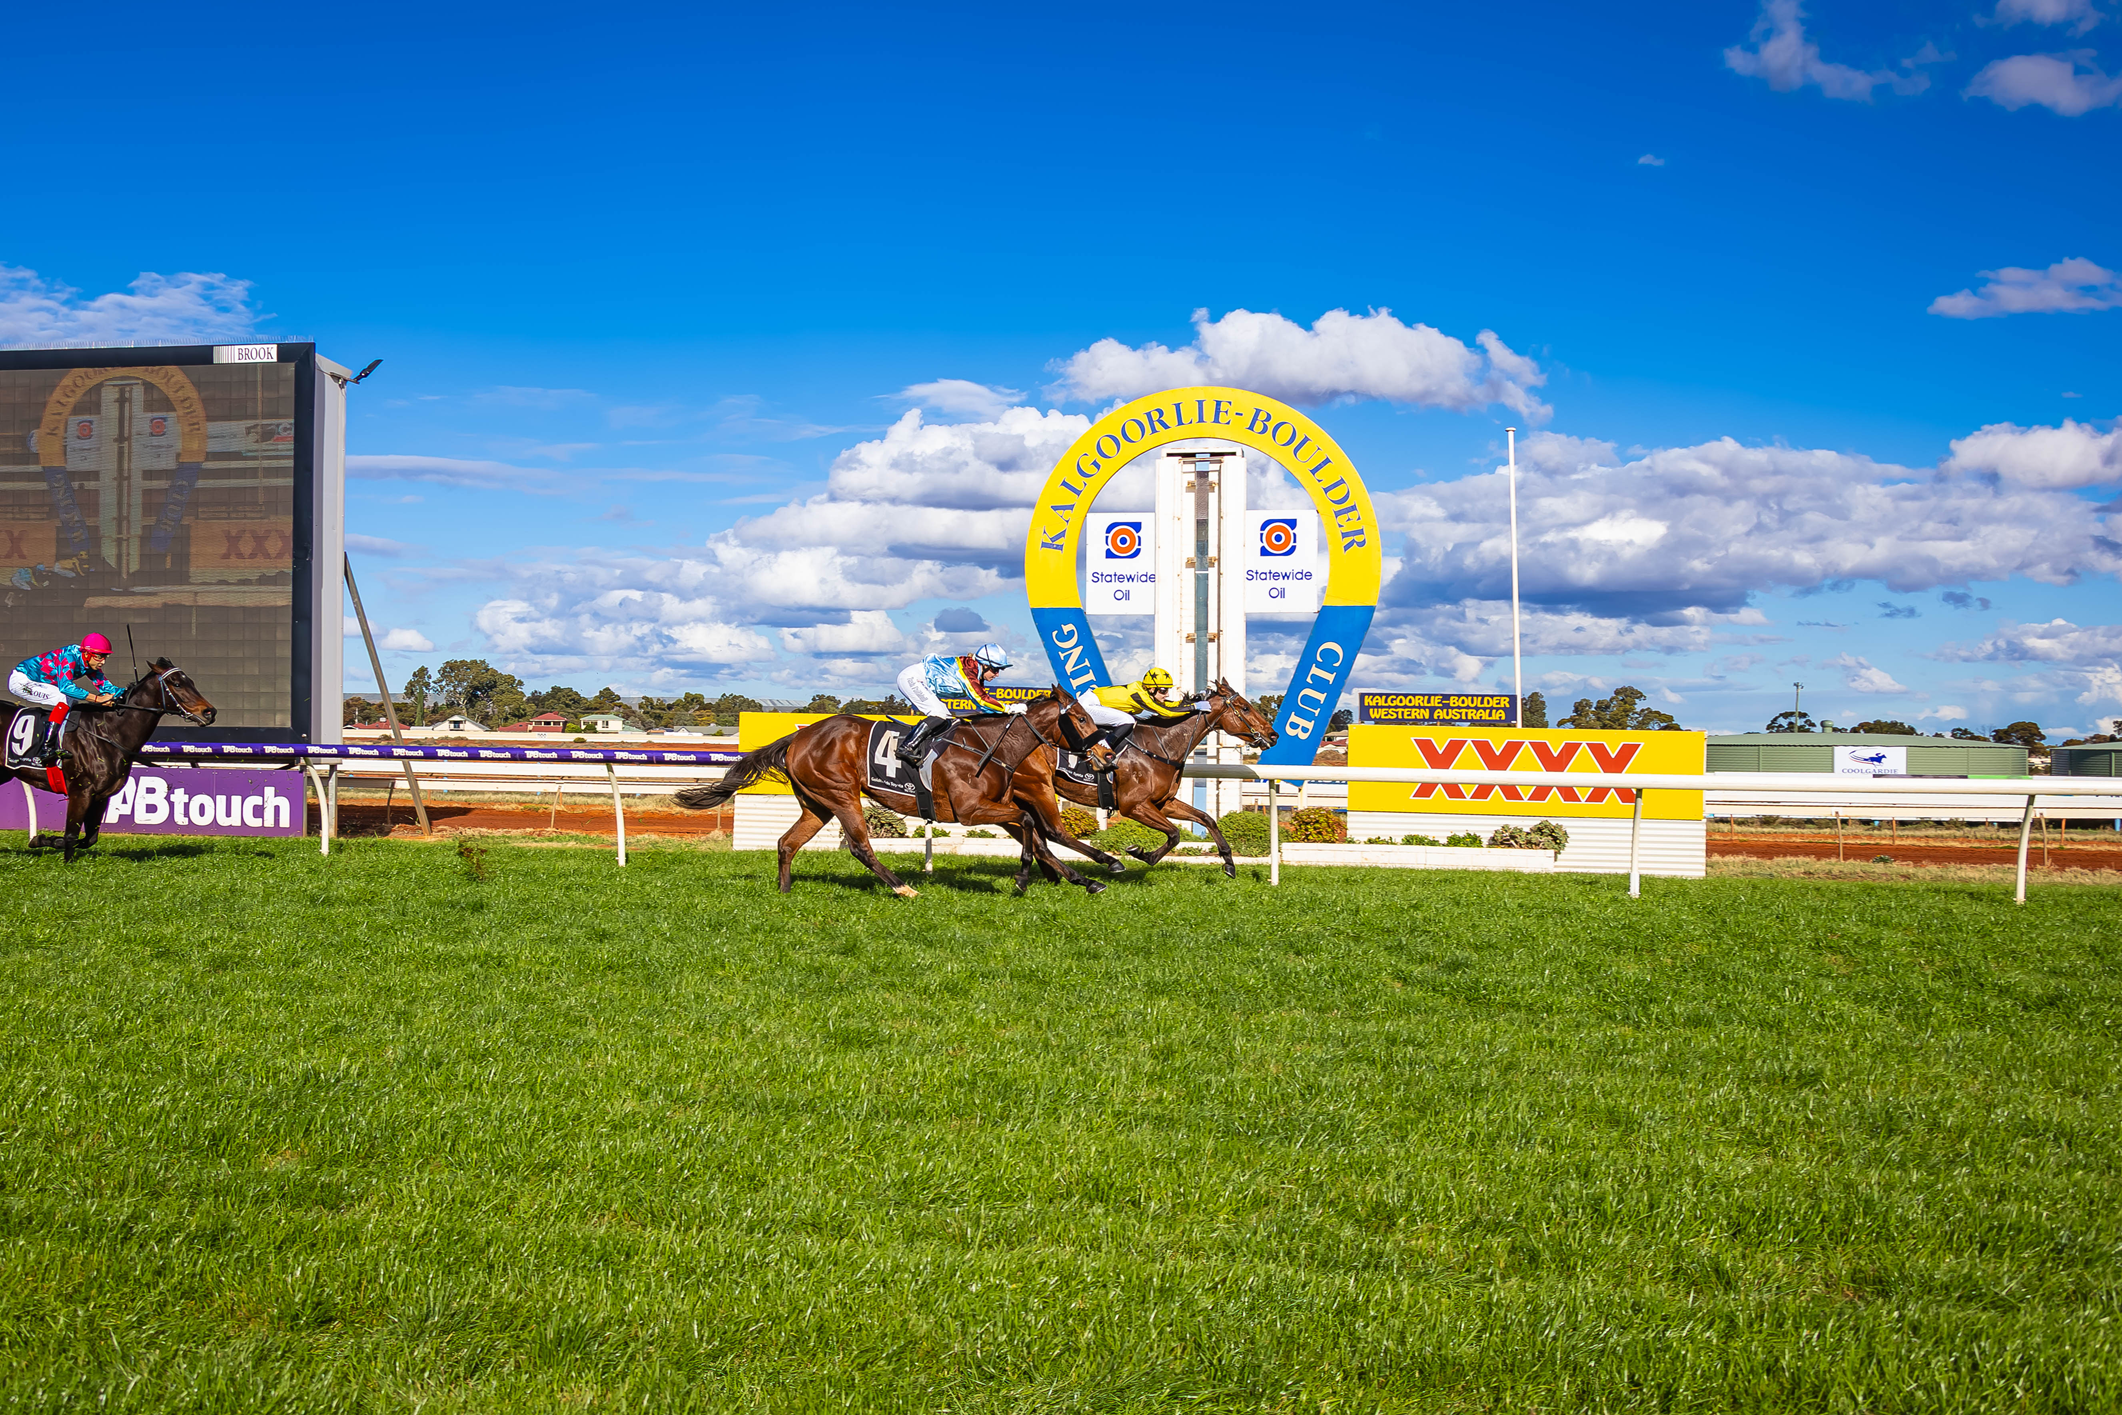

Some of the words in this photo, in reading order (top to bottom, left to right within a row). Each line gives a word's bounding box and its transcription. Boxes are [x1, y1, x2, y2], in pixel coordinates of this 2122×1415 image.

[237, 347, 274, 361] BROOK
[1040, 399, 1366, 553] KALGOORLIE-BOULDER
[1091, 571, 1156, 583] Statewide
[1245, 569, 1313, 581] Statewide
[1113, 589, 1130, 601] Oil
[1268, 587, 1286, 599] Oil
[1052, 623, 1099, 699] ING
[1285, 641, 1344, 740] CLUB
[1364, 695, 1510, 708] KALGOORLIE-BOULDER
[1369, 708, 1429, 720] WESTERN
[1433, 708, 1506, 720] AUSTRALIA
[12, 715, 35, 756] 9
[874, 730, 902, 778] 4
[1409, 737, 1644, 804] XXXX
[101, 776, 290, 828] ABtouch
